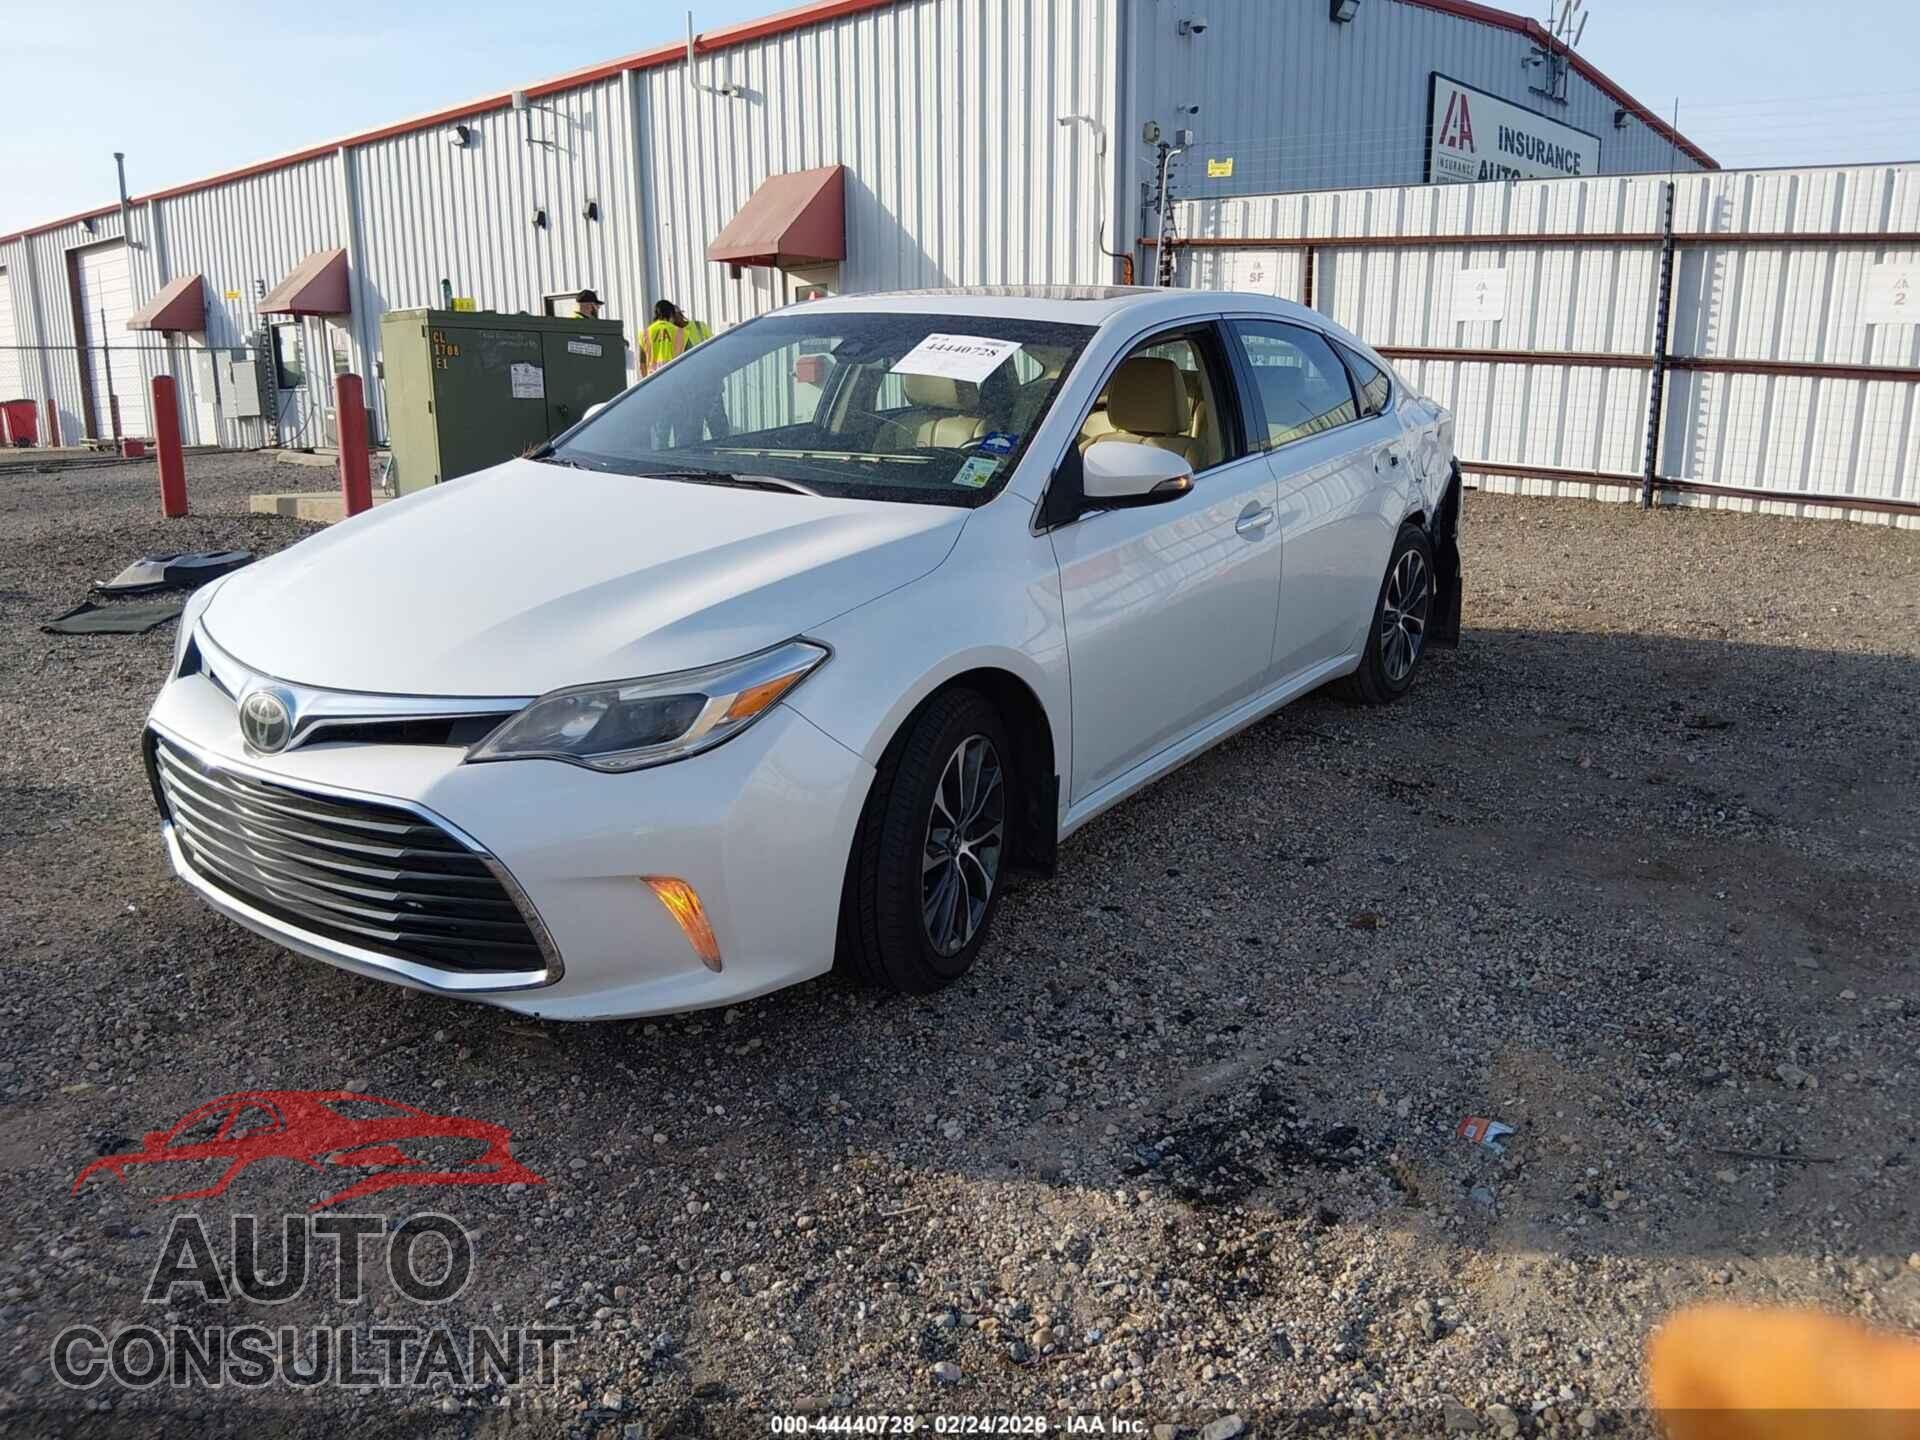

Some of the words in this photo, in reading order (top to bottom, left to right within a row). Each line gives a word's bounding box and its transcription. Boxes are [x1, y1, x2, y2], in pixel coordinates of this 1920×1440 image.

[1498, 124, 1581, 176] INSURANCE
[1249, 271, 1264, 282] SF
[1895, 292, 1905, 305] 2
[926, 343, 999, 357] 44440728
